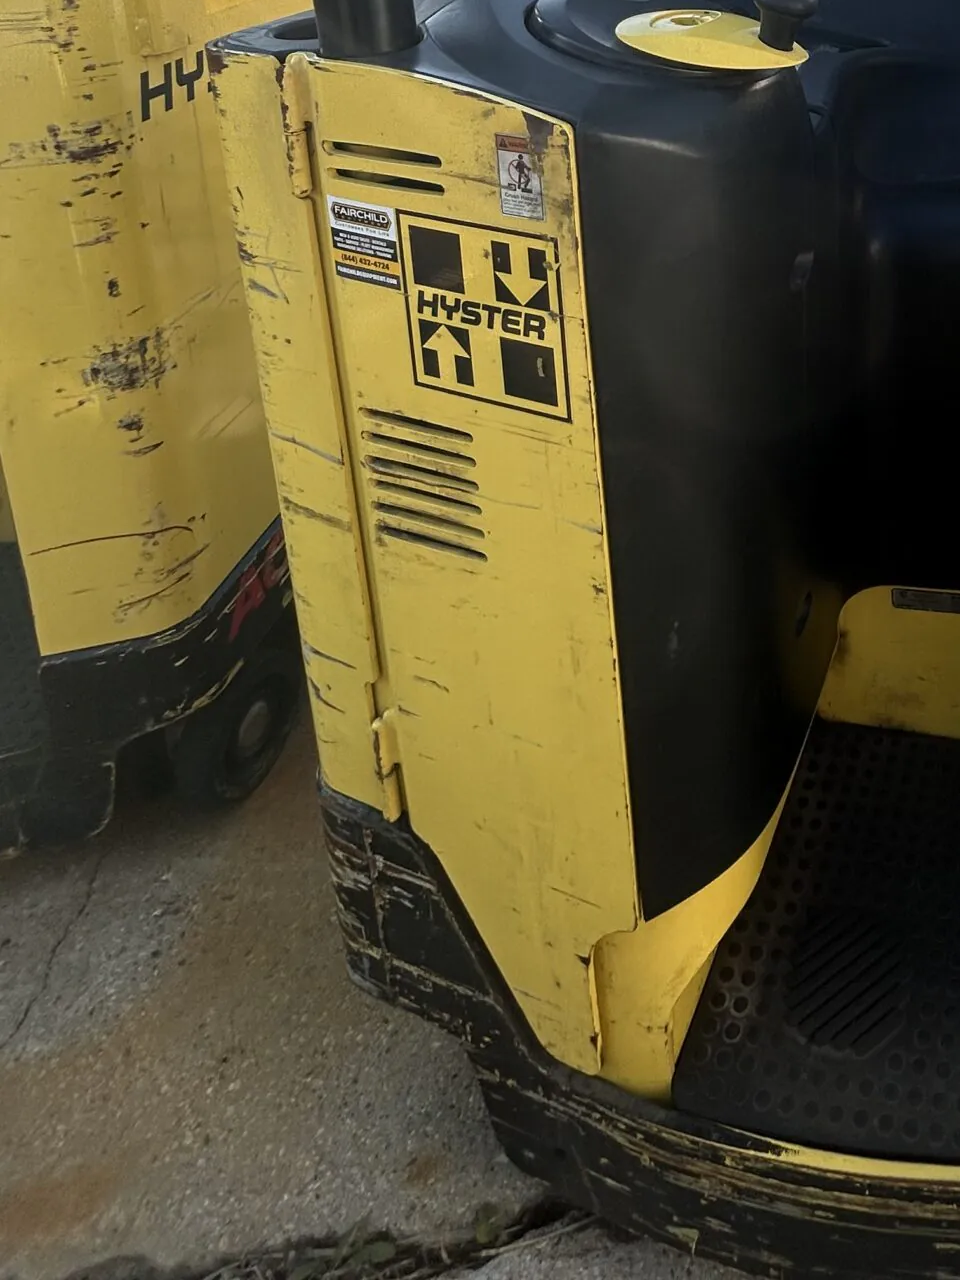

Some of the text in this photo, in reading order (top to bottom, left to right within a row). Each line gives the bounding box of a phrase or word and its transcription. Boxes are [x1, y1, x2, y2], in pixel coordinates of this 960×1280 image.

[334, 205, 388, 224] FAIRCHILD
[341, 253, 358, 264] (844)
[417, 290, 547, 341] HYSTER
